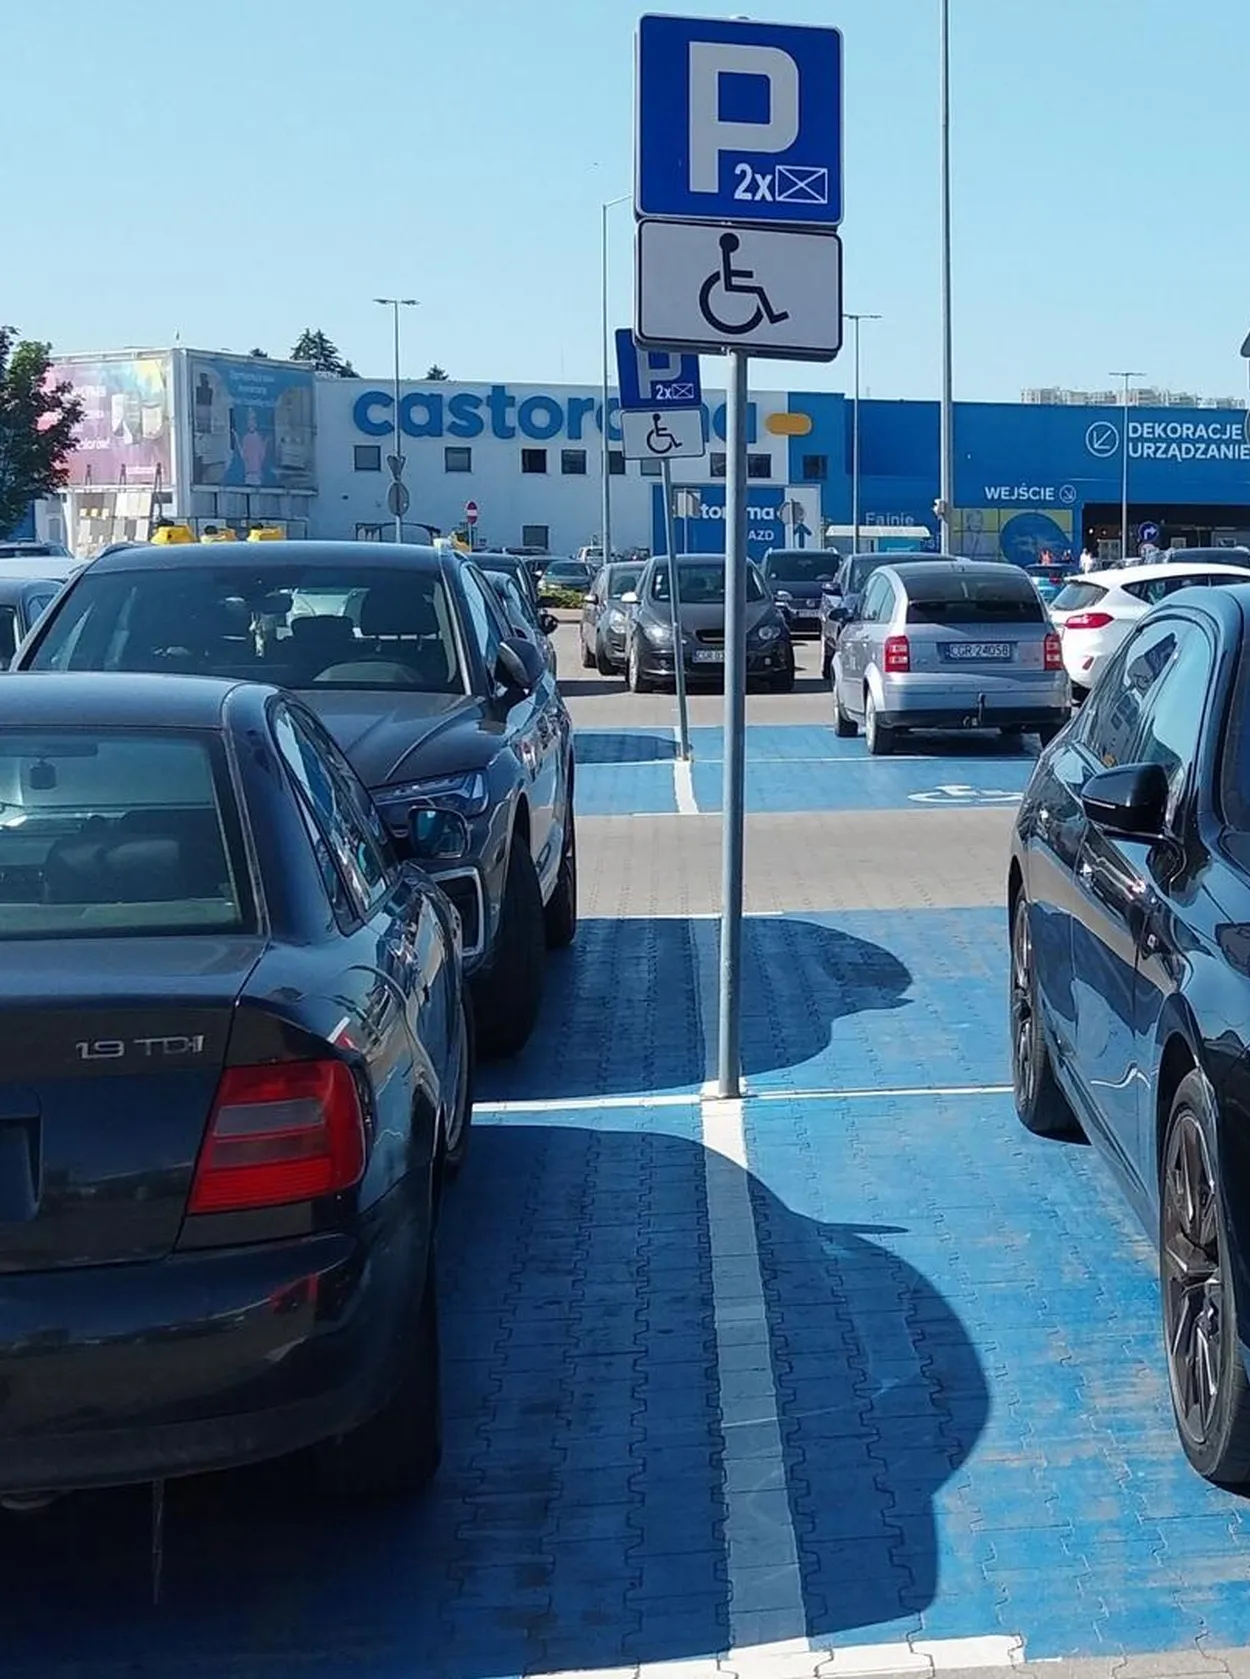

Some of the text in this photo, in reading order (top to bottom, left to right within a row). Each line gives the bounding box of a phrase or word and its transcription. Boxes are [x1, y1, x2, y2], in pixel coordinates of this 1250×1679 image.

[689, 41, 800, 193] P
[1128, 422, 1243, 440] DEKORACJE
[1128, 442, 1250, 462] URZĄDZANIE
[984, 482, 1055, 501] WEJŚCIE
